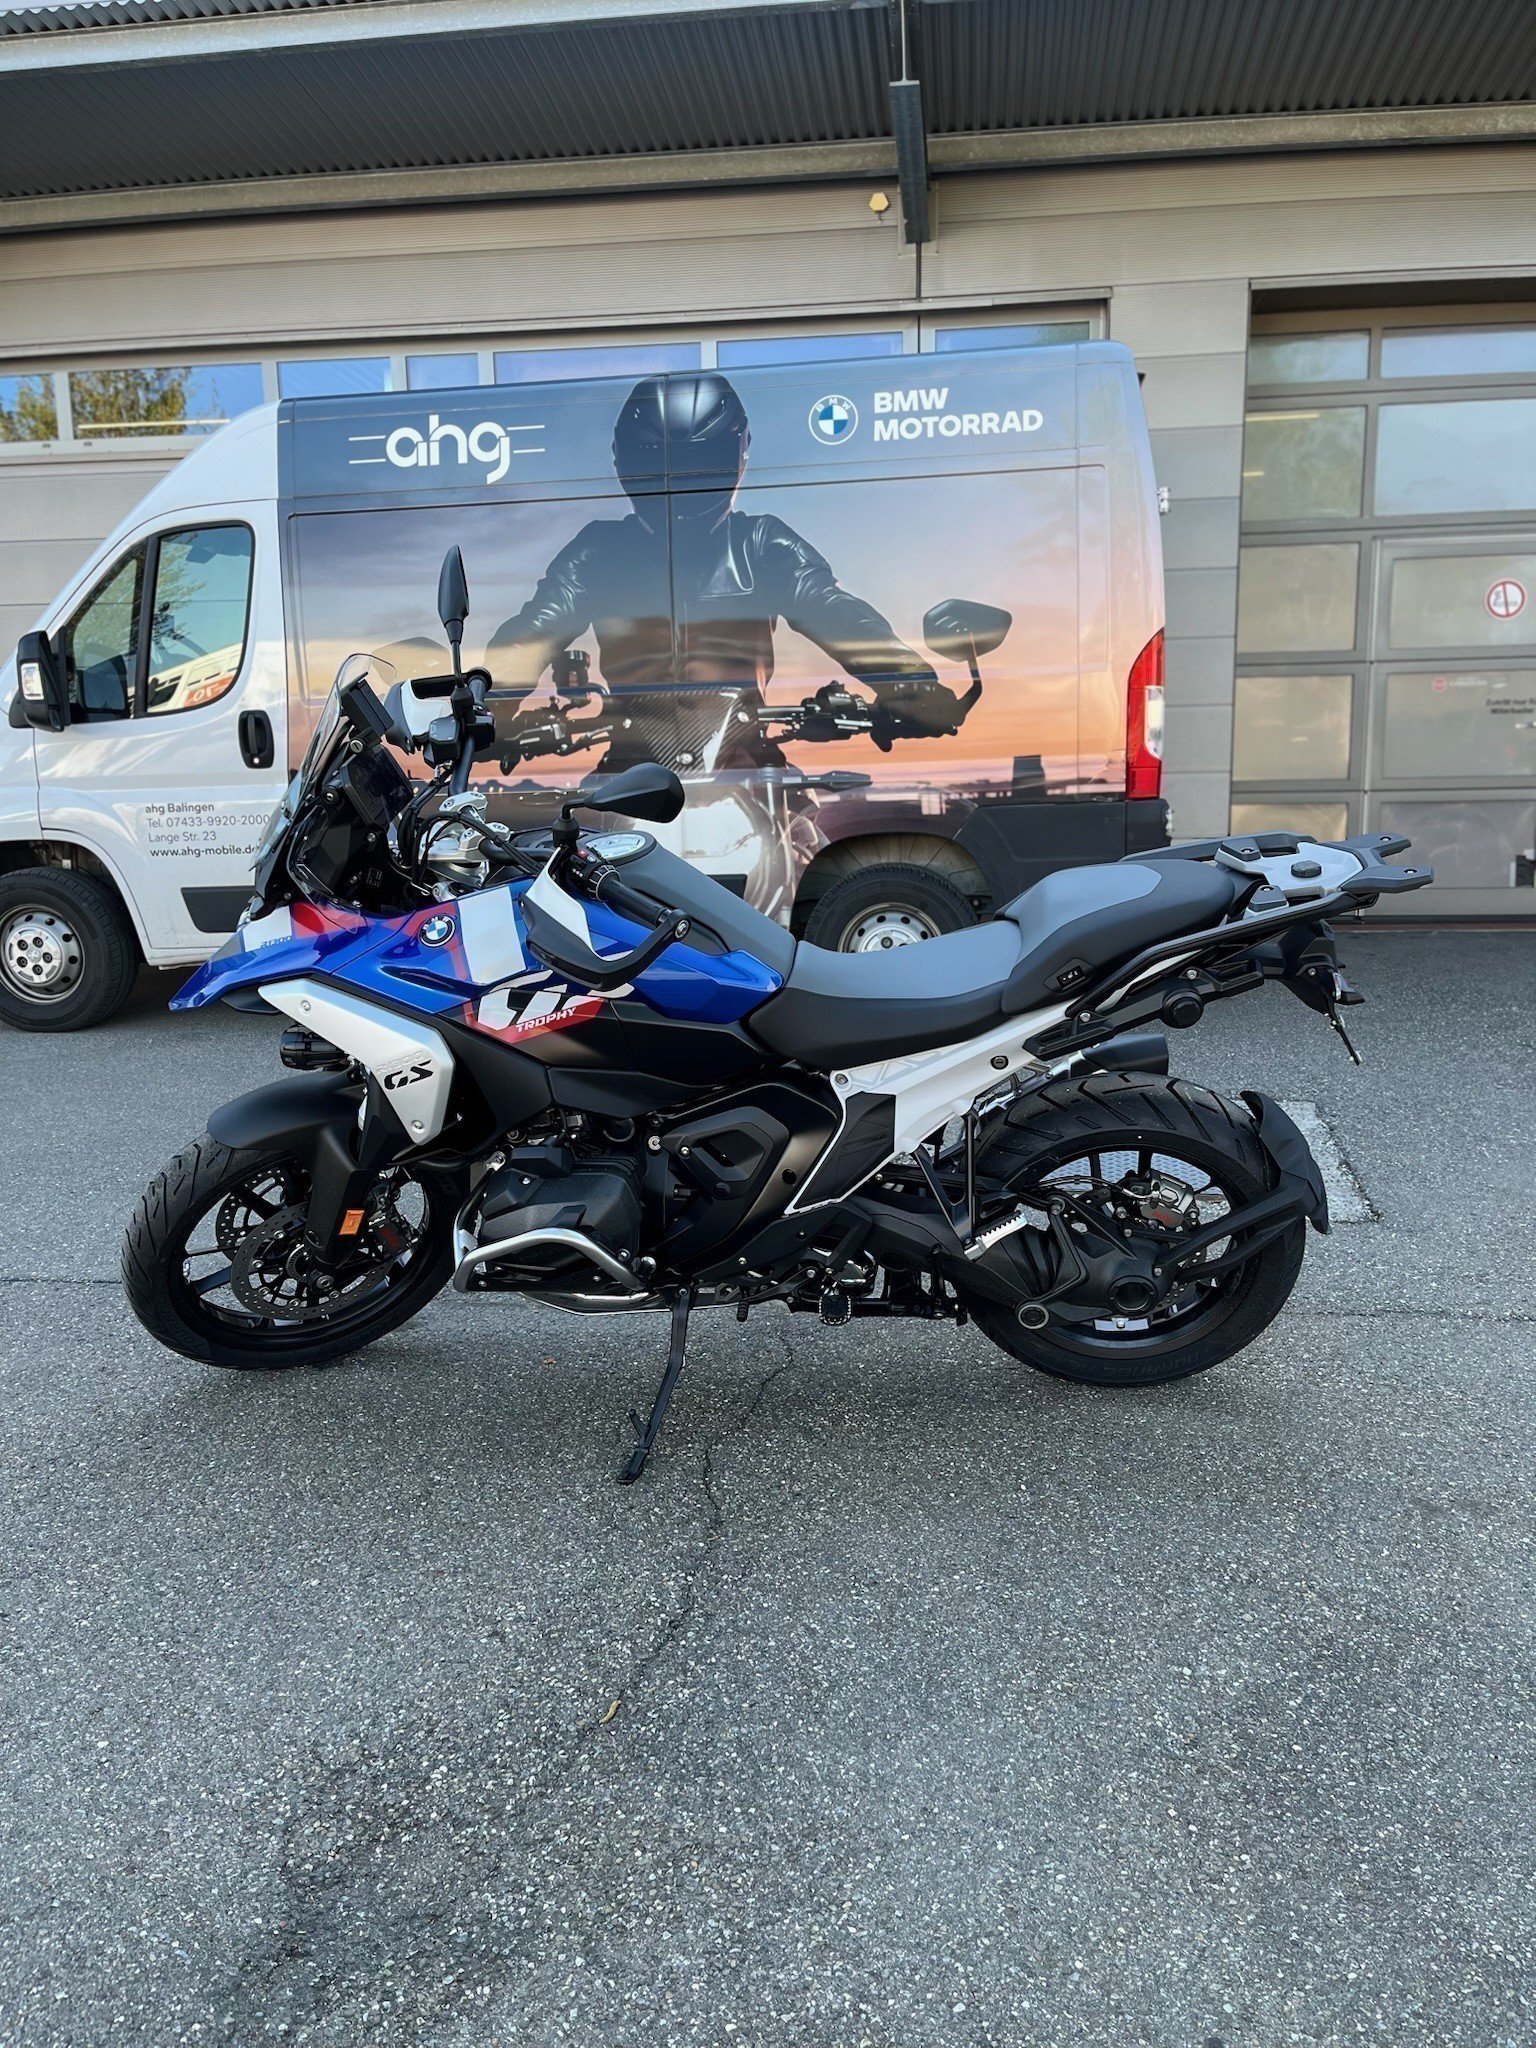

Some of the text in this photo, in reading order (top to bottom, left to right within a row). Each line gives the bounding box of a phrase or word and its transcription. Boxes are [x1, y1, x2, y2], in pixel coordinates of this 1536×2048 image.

[815, 397, 851, 412] BMW
[873, 387, 949, 414] BMW
[873, 409, 1044, 442] MOTORRAD
[386, 414, 511, 485] ahg
[145, 802, 215, 815] ahg Balingen
[166, 814, 271, 828] 07433-9920-2000
[148, 831, 217, 844] Lange Str. 23
[515, 1006, 576, 1033] TROPHY
[383, 1059, 434, 1090] GS
